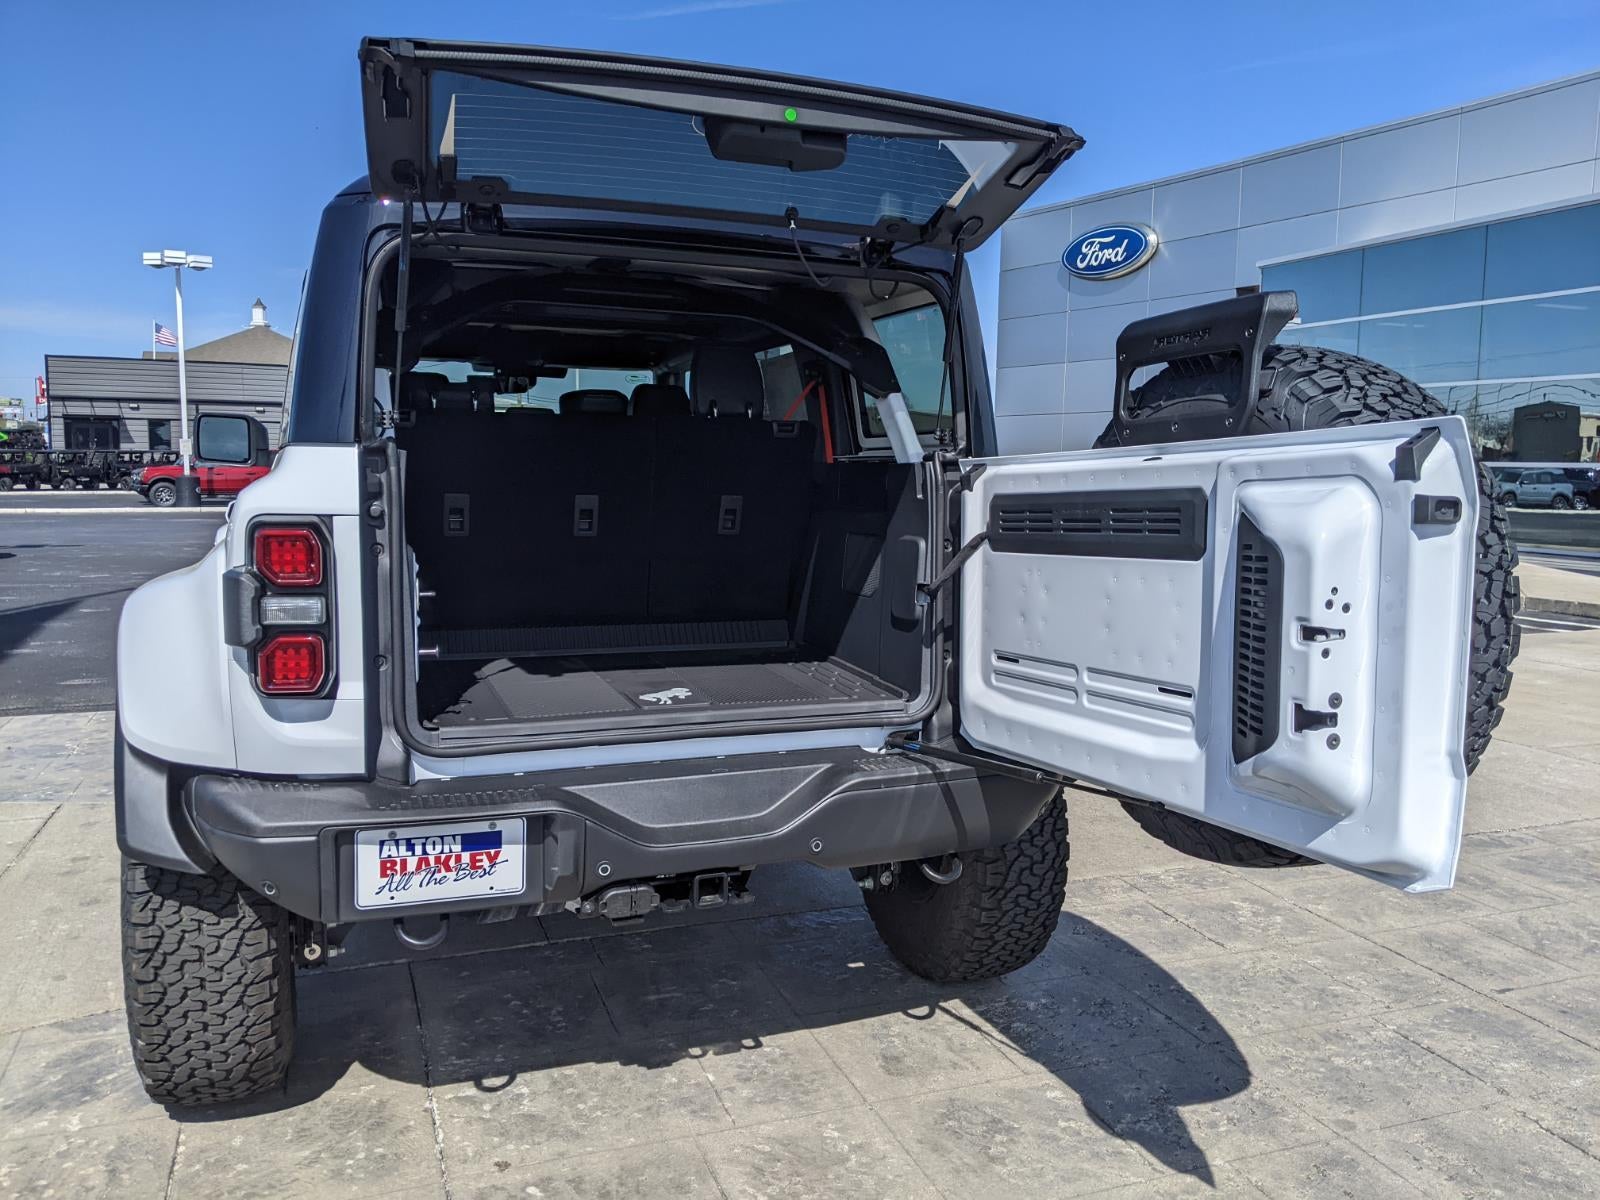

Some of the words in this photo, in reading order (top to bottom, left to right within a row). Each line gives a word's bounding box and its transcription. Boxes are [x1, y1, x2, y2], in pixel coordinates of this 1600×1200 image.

[1076, 235, 1129, 269] Ford
[380, 835, 462, 858] ALTON
[375, 871, 415, 895] All
[416, 866, 450, 888] The
[453, 859, 509, 882] Best
[379, 850, 502, 878] BLAKLEY
